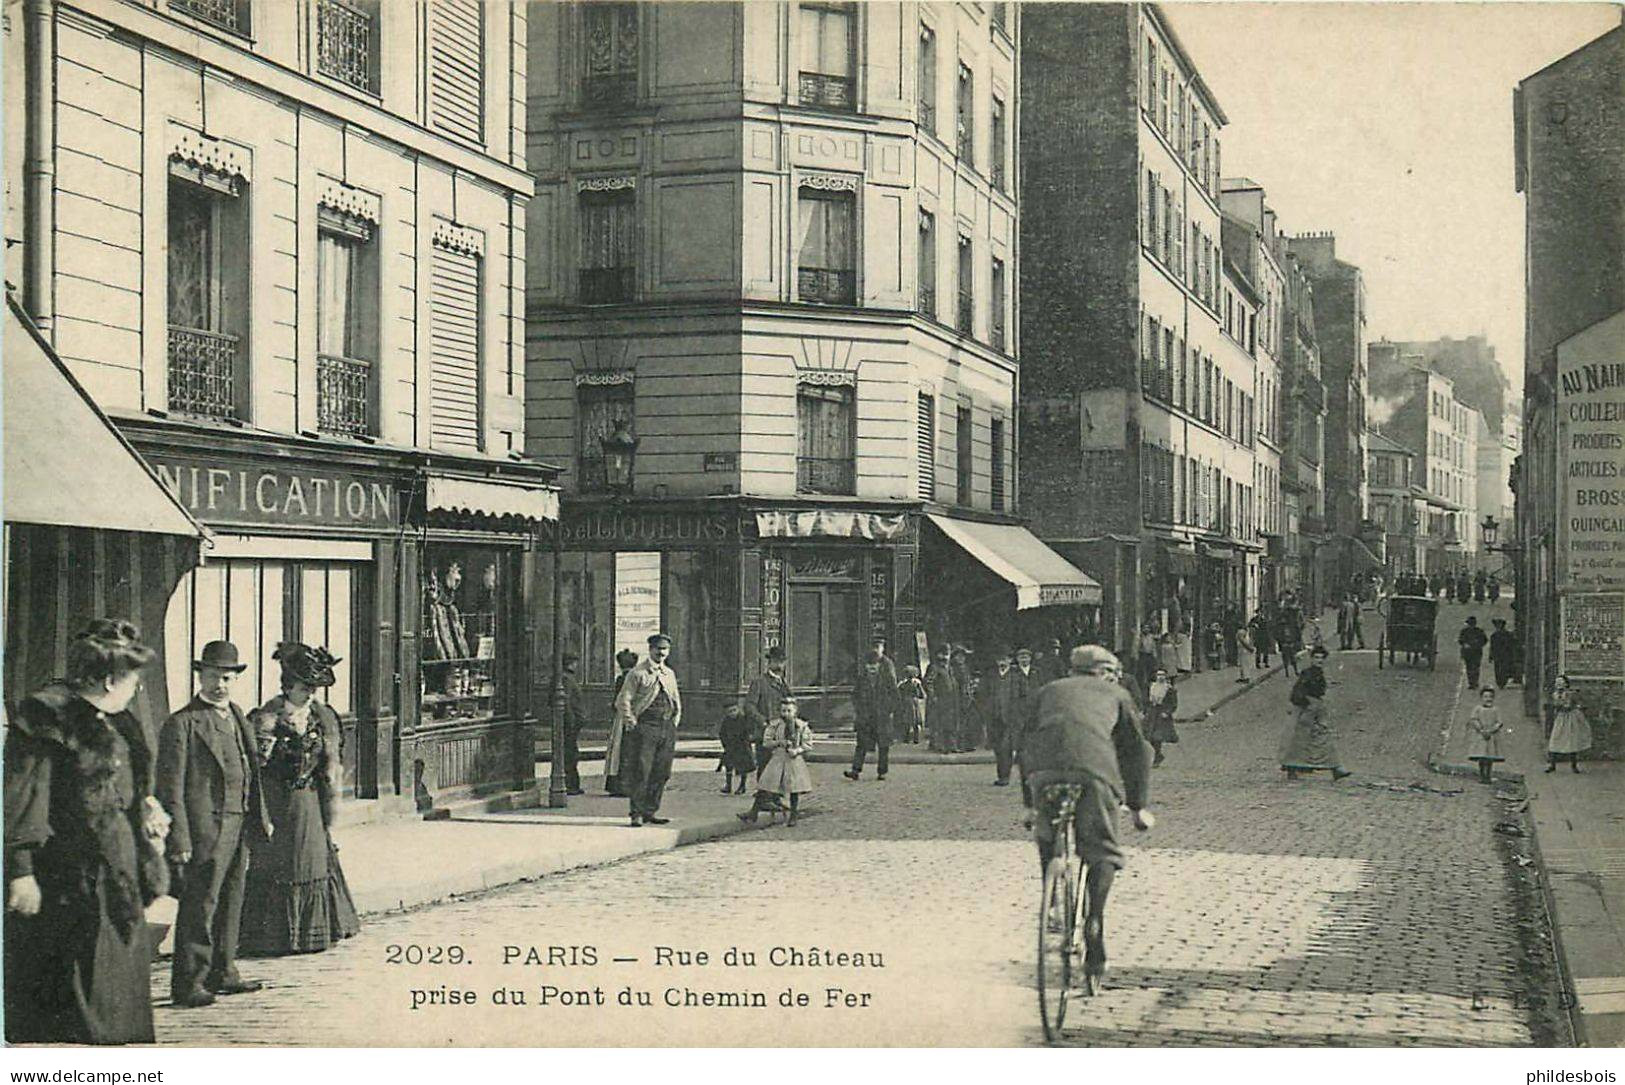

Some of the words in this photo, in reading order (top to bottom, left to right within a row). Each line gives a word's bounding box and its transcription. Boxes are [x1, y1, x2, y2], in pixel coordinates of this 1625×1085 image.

[1562, 370, 1582, 396] AU
[1573, 433, 1622, 449] PRODUITS
[1569, 461, 1617, 478] ARTICLES
[156, 464, 392, 521] NIFICATION
